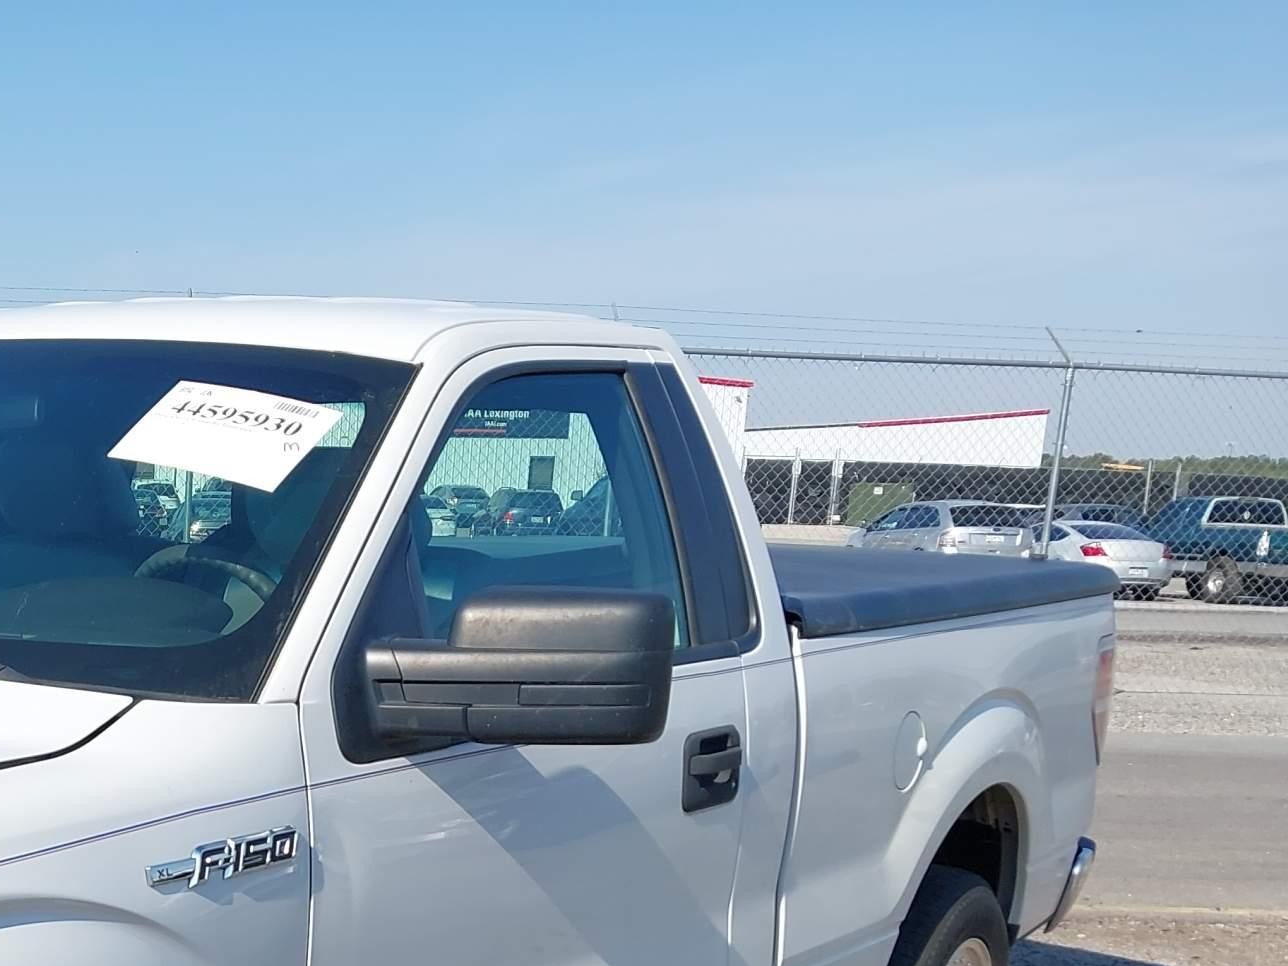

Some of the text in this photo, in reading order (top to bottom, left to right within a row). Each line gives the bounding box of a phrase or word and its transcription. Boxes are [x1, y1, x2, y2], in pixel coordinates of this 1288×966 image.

[171, 400, 303, 437] 44595930
[484, 409, 530, 420] Lexington
[157, 868, 174, 879] XL
